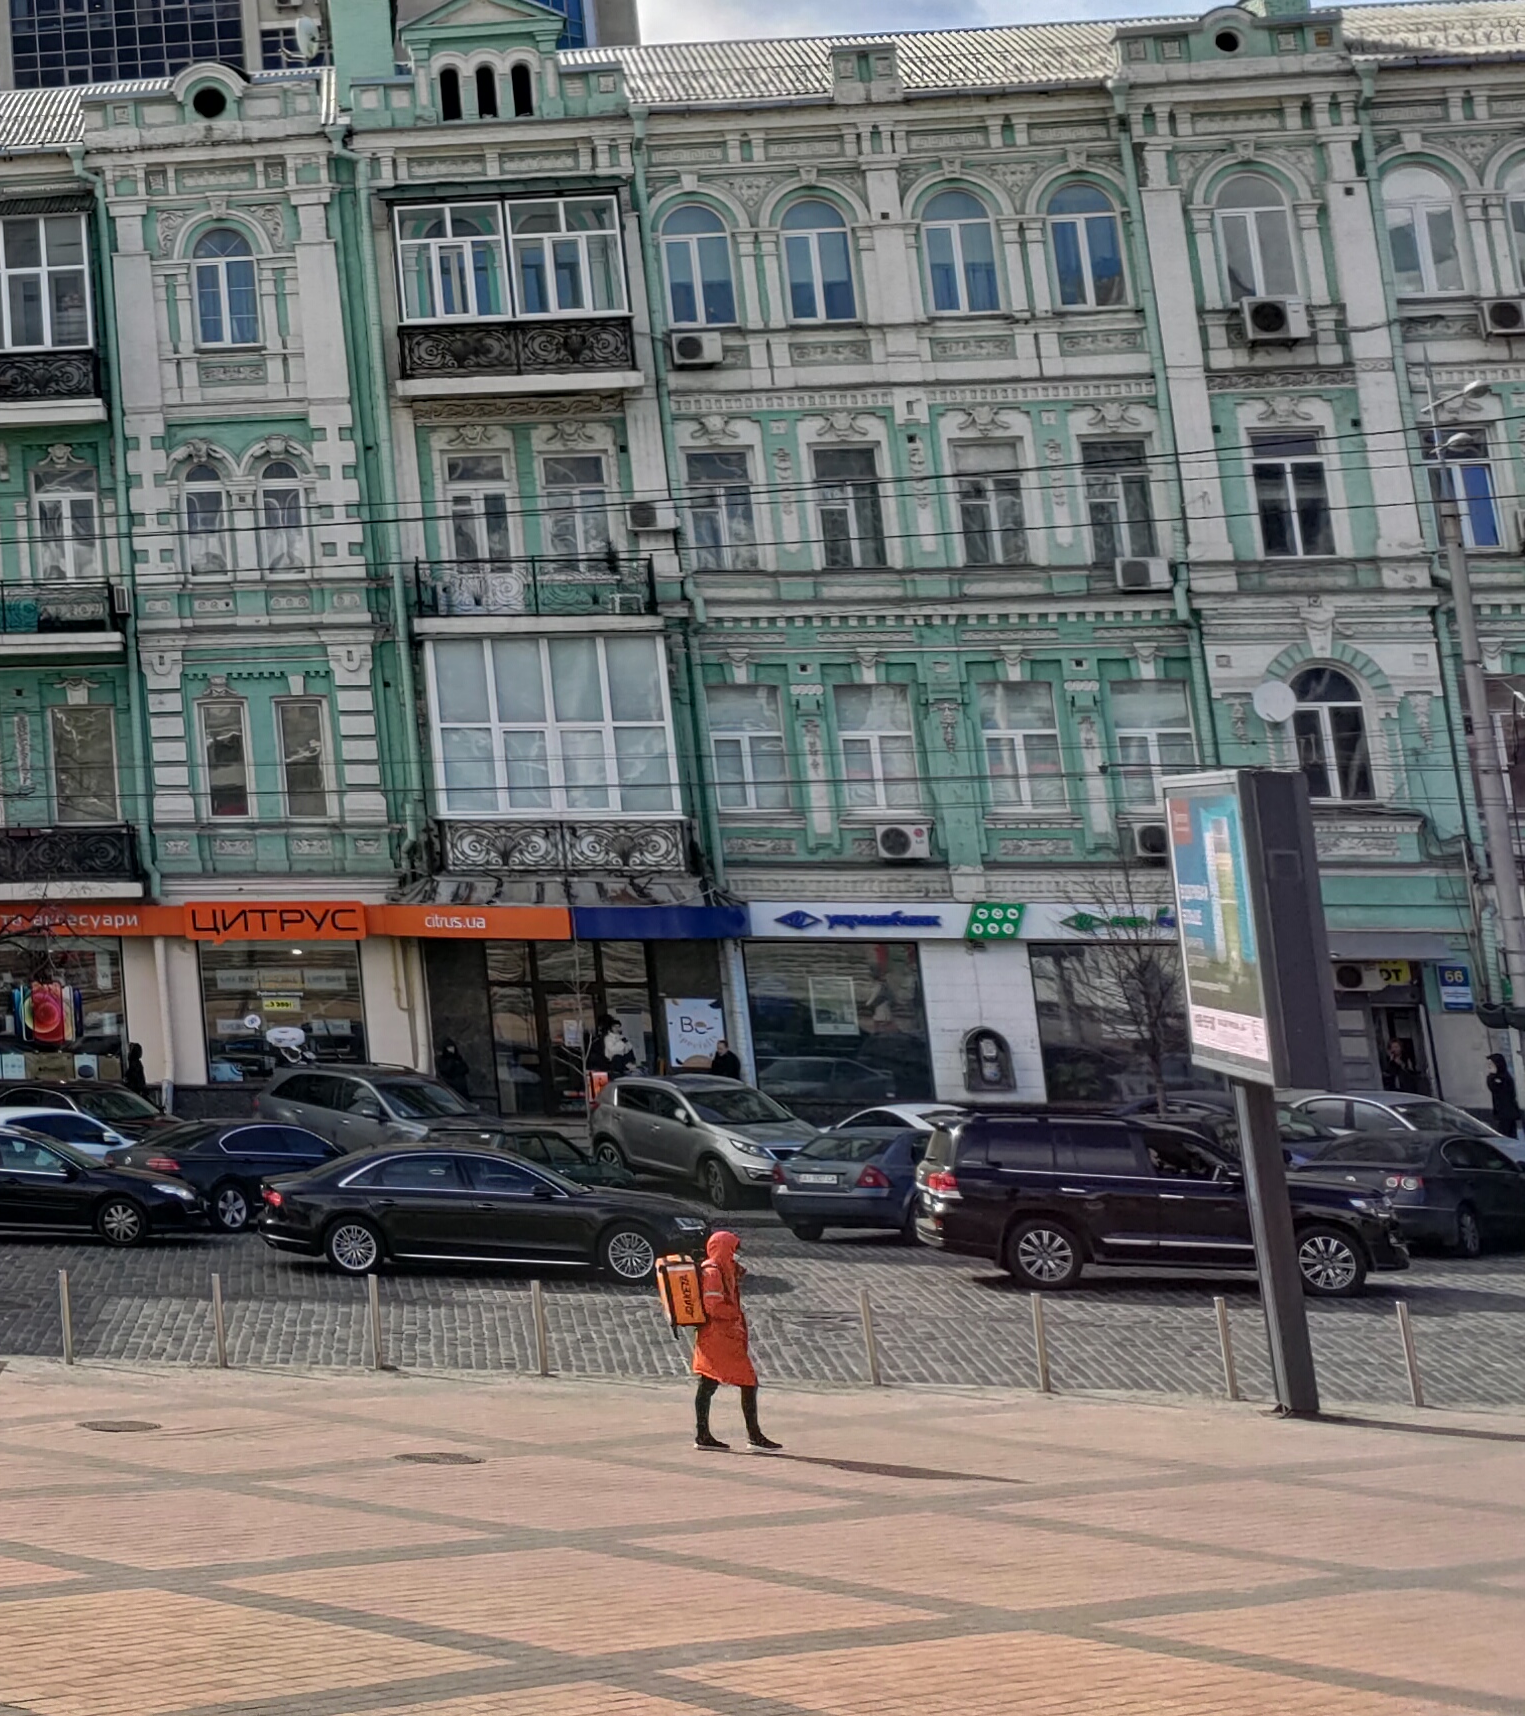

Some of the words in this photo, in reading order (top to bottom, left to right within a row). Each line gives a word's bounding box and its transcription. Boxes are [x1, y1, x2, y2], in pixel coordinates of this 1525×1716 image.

[191, 908, 359, 935] ЦИТРУС
[424, 914, 486, 929] citrus.ua
[1445, 970, 1464, 983] 66
